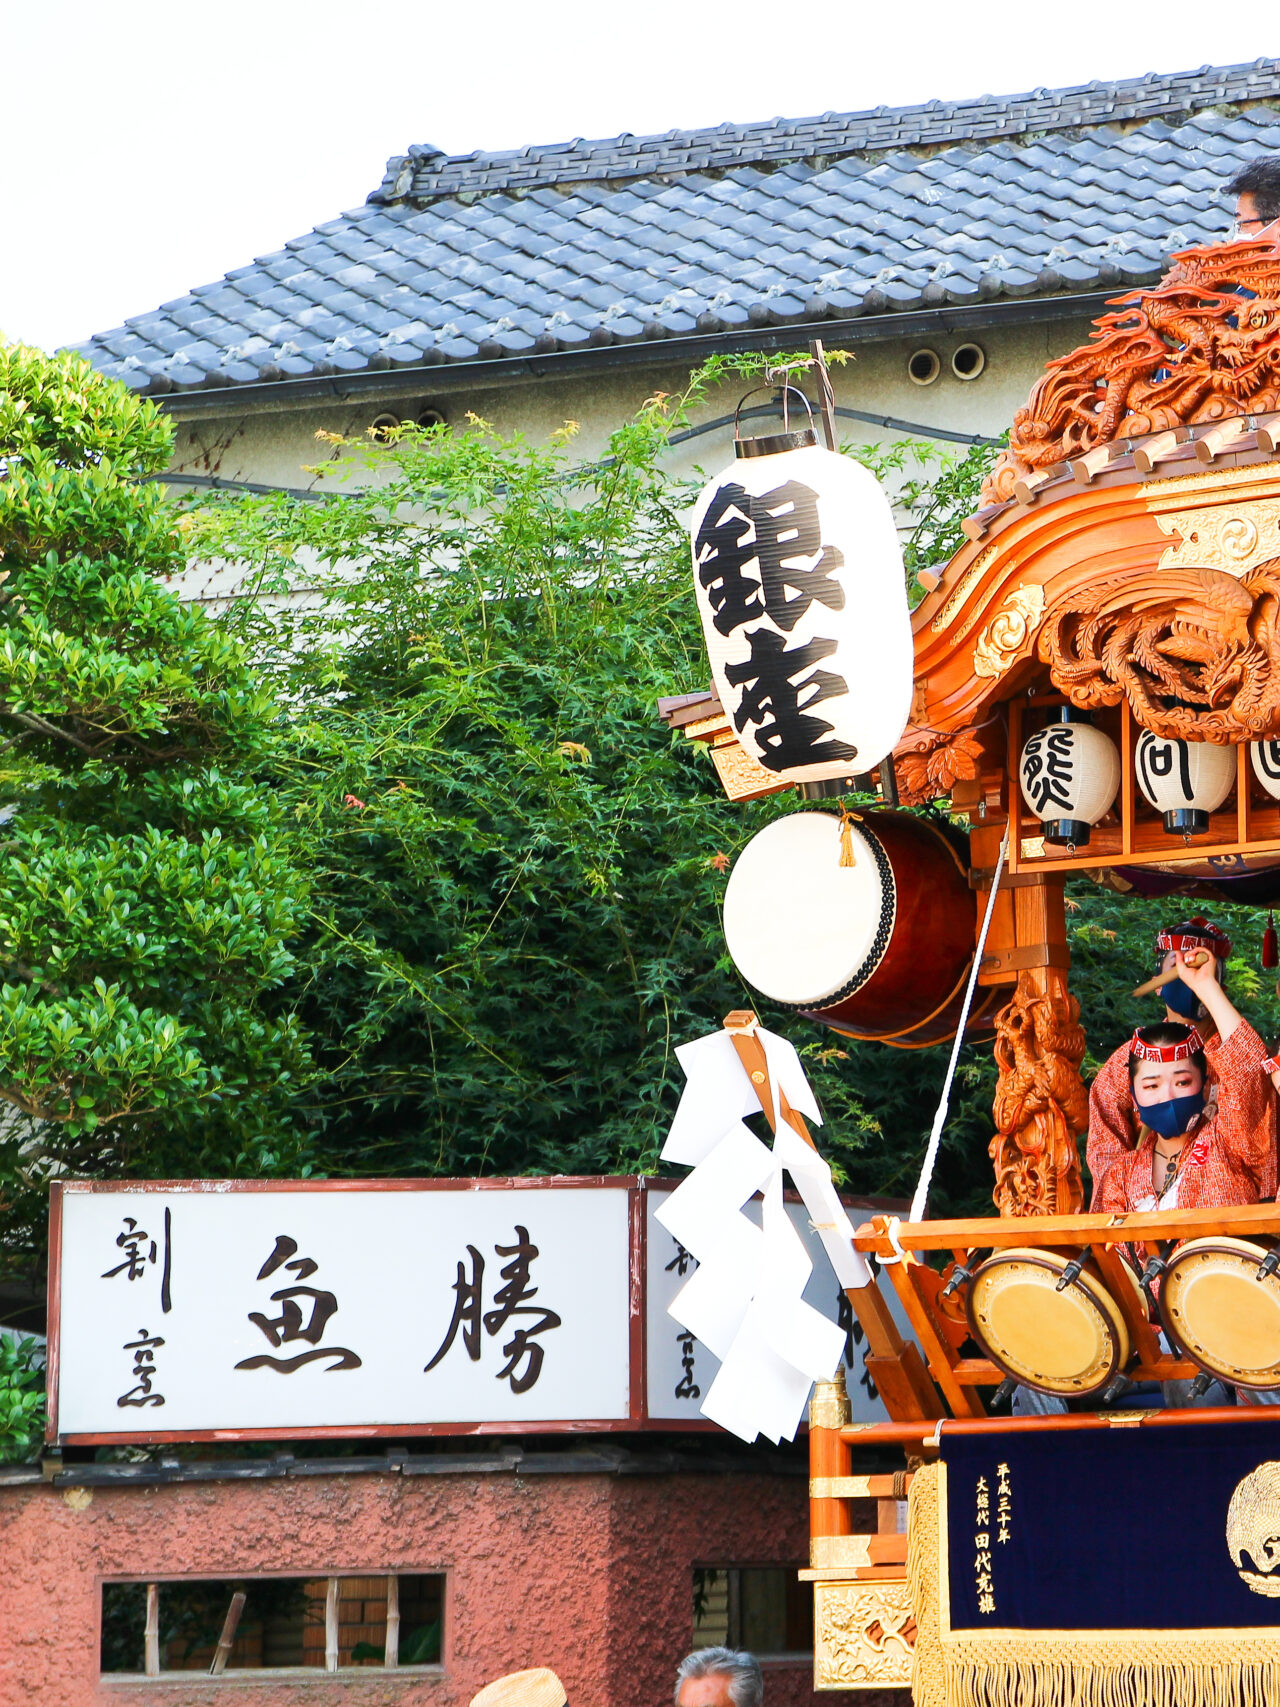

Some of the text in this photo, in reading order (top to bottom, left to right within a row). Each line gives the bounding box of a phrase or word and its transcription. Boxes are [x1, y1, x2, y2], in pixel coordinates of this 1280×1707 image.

[695, 480, 859, 772] 銀座
[996, 1463, 1012, 1546] 平成三十年
